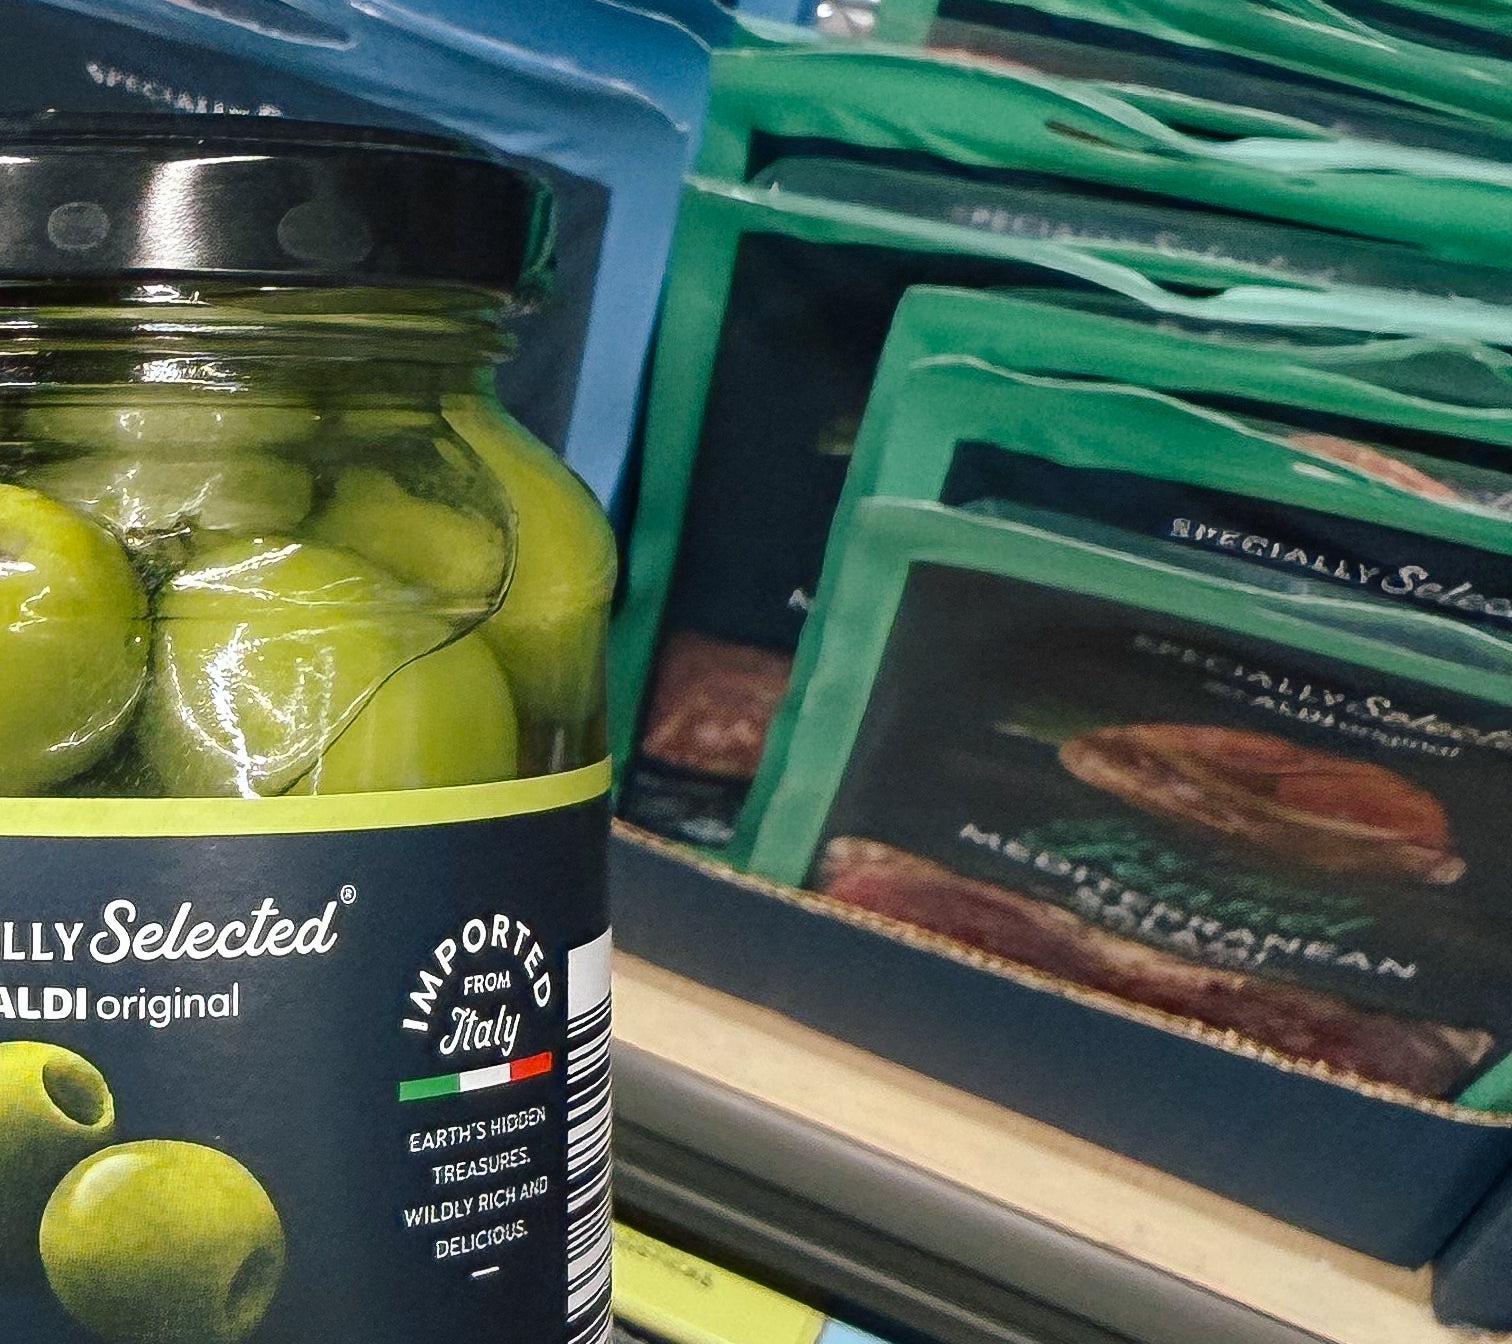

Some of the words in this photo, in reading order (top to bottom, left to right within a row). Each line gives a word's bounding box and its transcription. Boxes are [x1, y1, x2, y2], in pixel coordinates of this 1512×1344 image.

[1170, 517, 1380, 585] SPECIALLY
[402, 913, 552, 1033] IMPORTED
[463, 970, 512, 996] FROM
[95, 982, 241, 1030] original
[439, 1004, 521, 1057] Italy
[409, 1119, 487, 1154] EARTH'S
[490, 1105, 547, 1137] HIDDEN
[431, 1145, 531, 1186] TREASURES.
[403, 1195, 473, 1229] WILDLY
[478, 1186, 516, 1213] RICH
[519, 1174, 549, 1199] AND
[435, 1218, 529, 1260] DELICIOUS.
